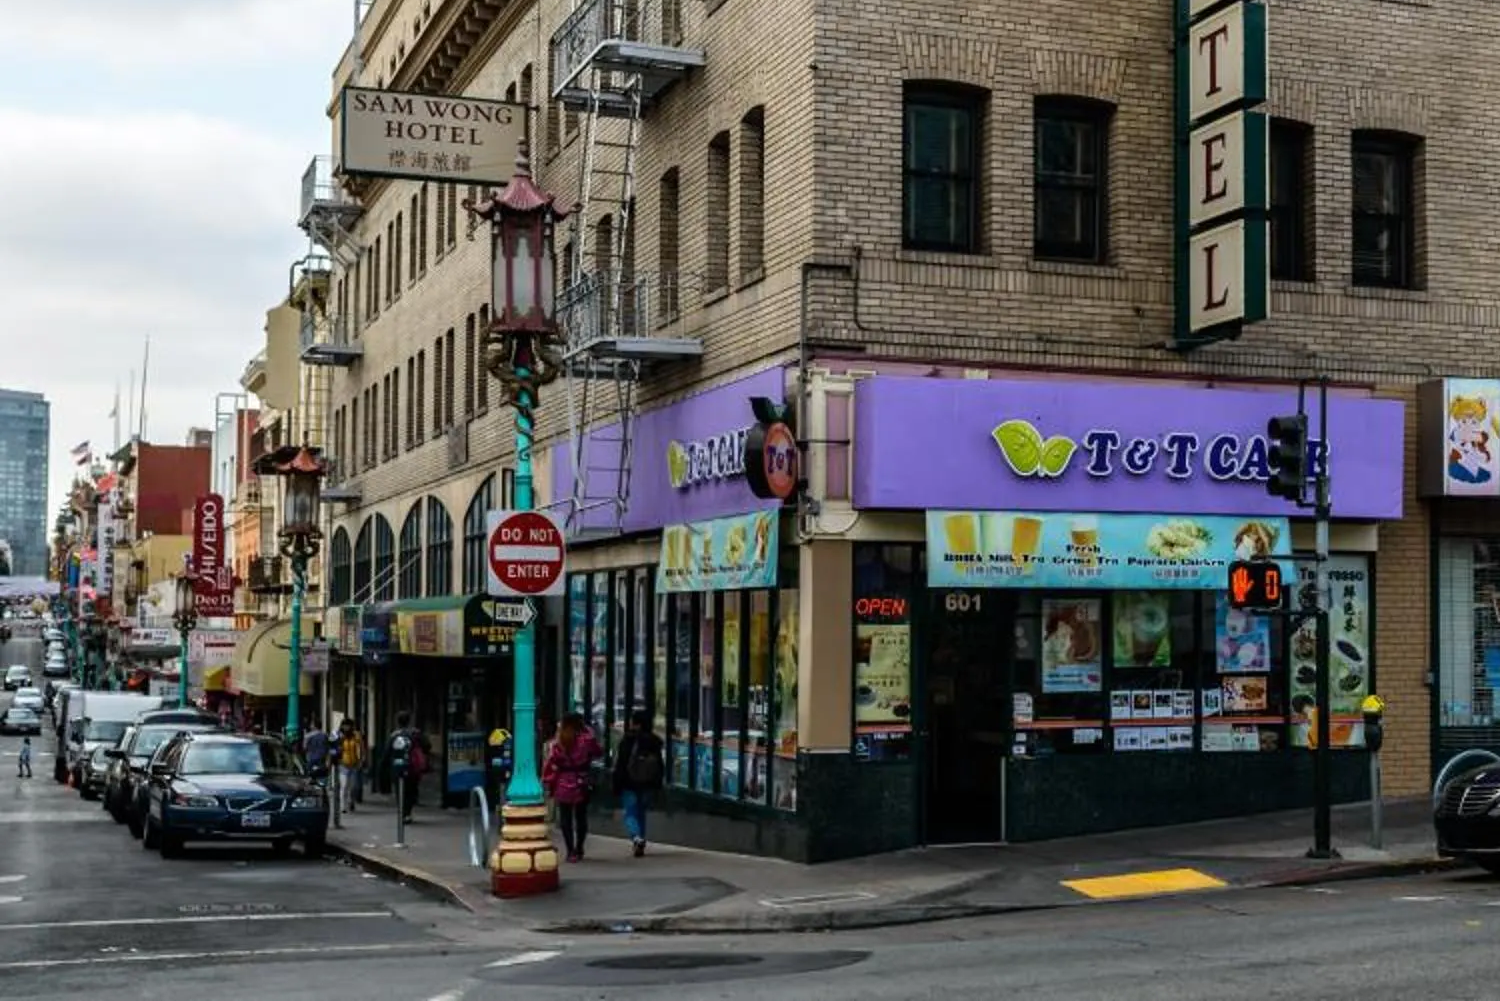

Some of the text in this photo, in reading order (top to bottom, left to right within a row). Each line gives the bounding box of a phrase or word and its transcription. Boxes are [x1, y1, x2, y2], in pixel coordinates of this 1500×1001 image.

[353, 93, 513, 125] SAM WONG
[384, 119, 484, 146] HOTEL
[1205, 434, 1331, 482] CAE
[200, 501, 218, 591] SHISEIDO
[500, 528, 556, 543] DO NOT
[507, 564, 550, 579] ENTER
[1264, 569, 1280, 600] 0
[855, 598, 906, 616] OPEN
[944, 593, 982, 612] 601
